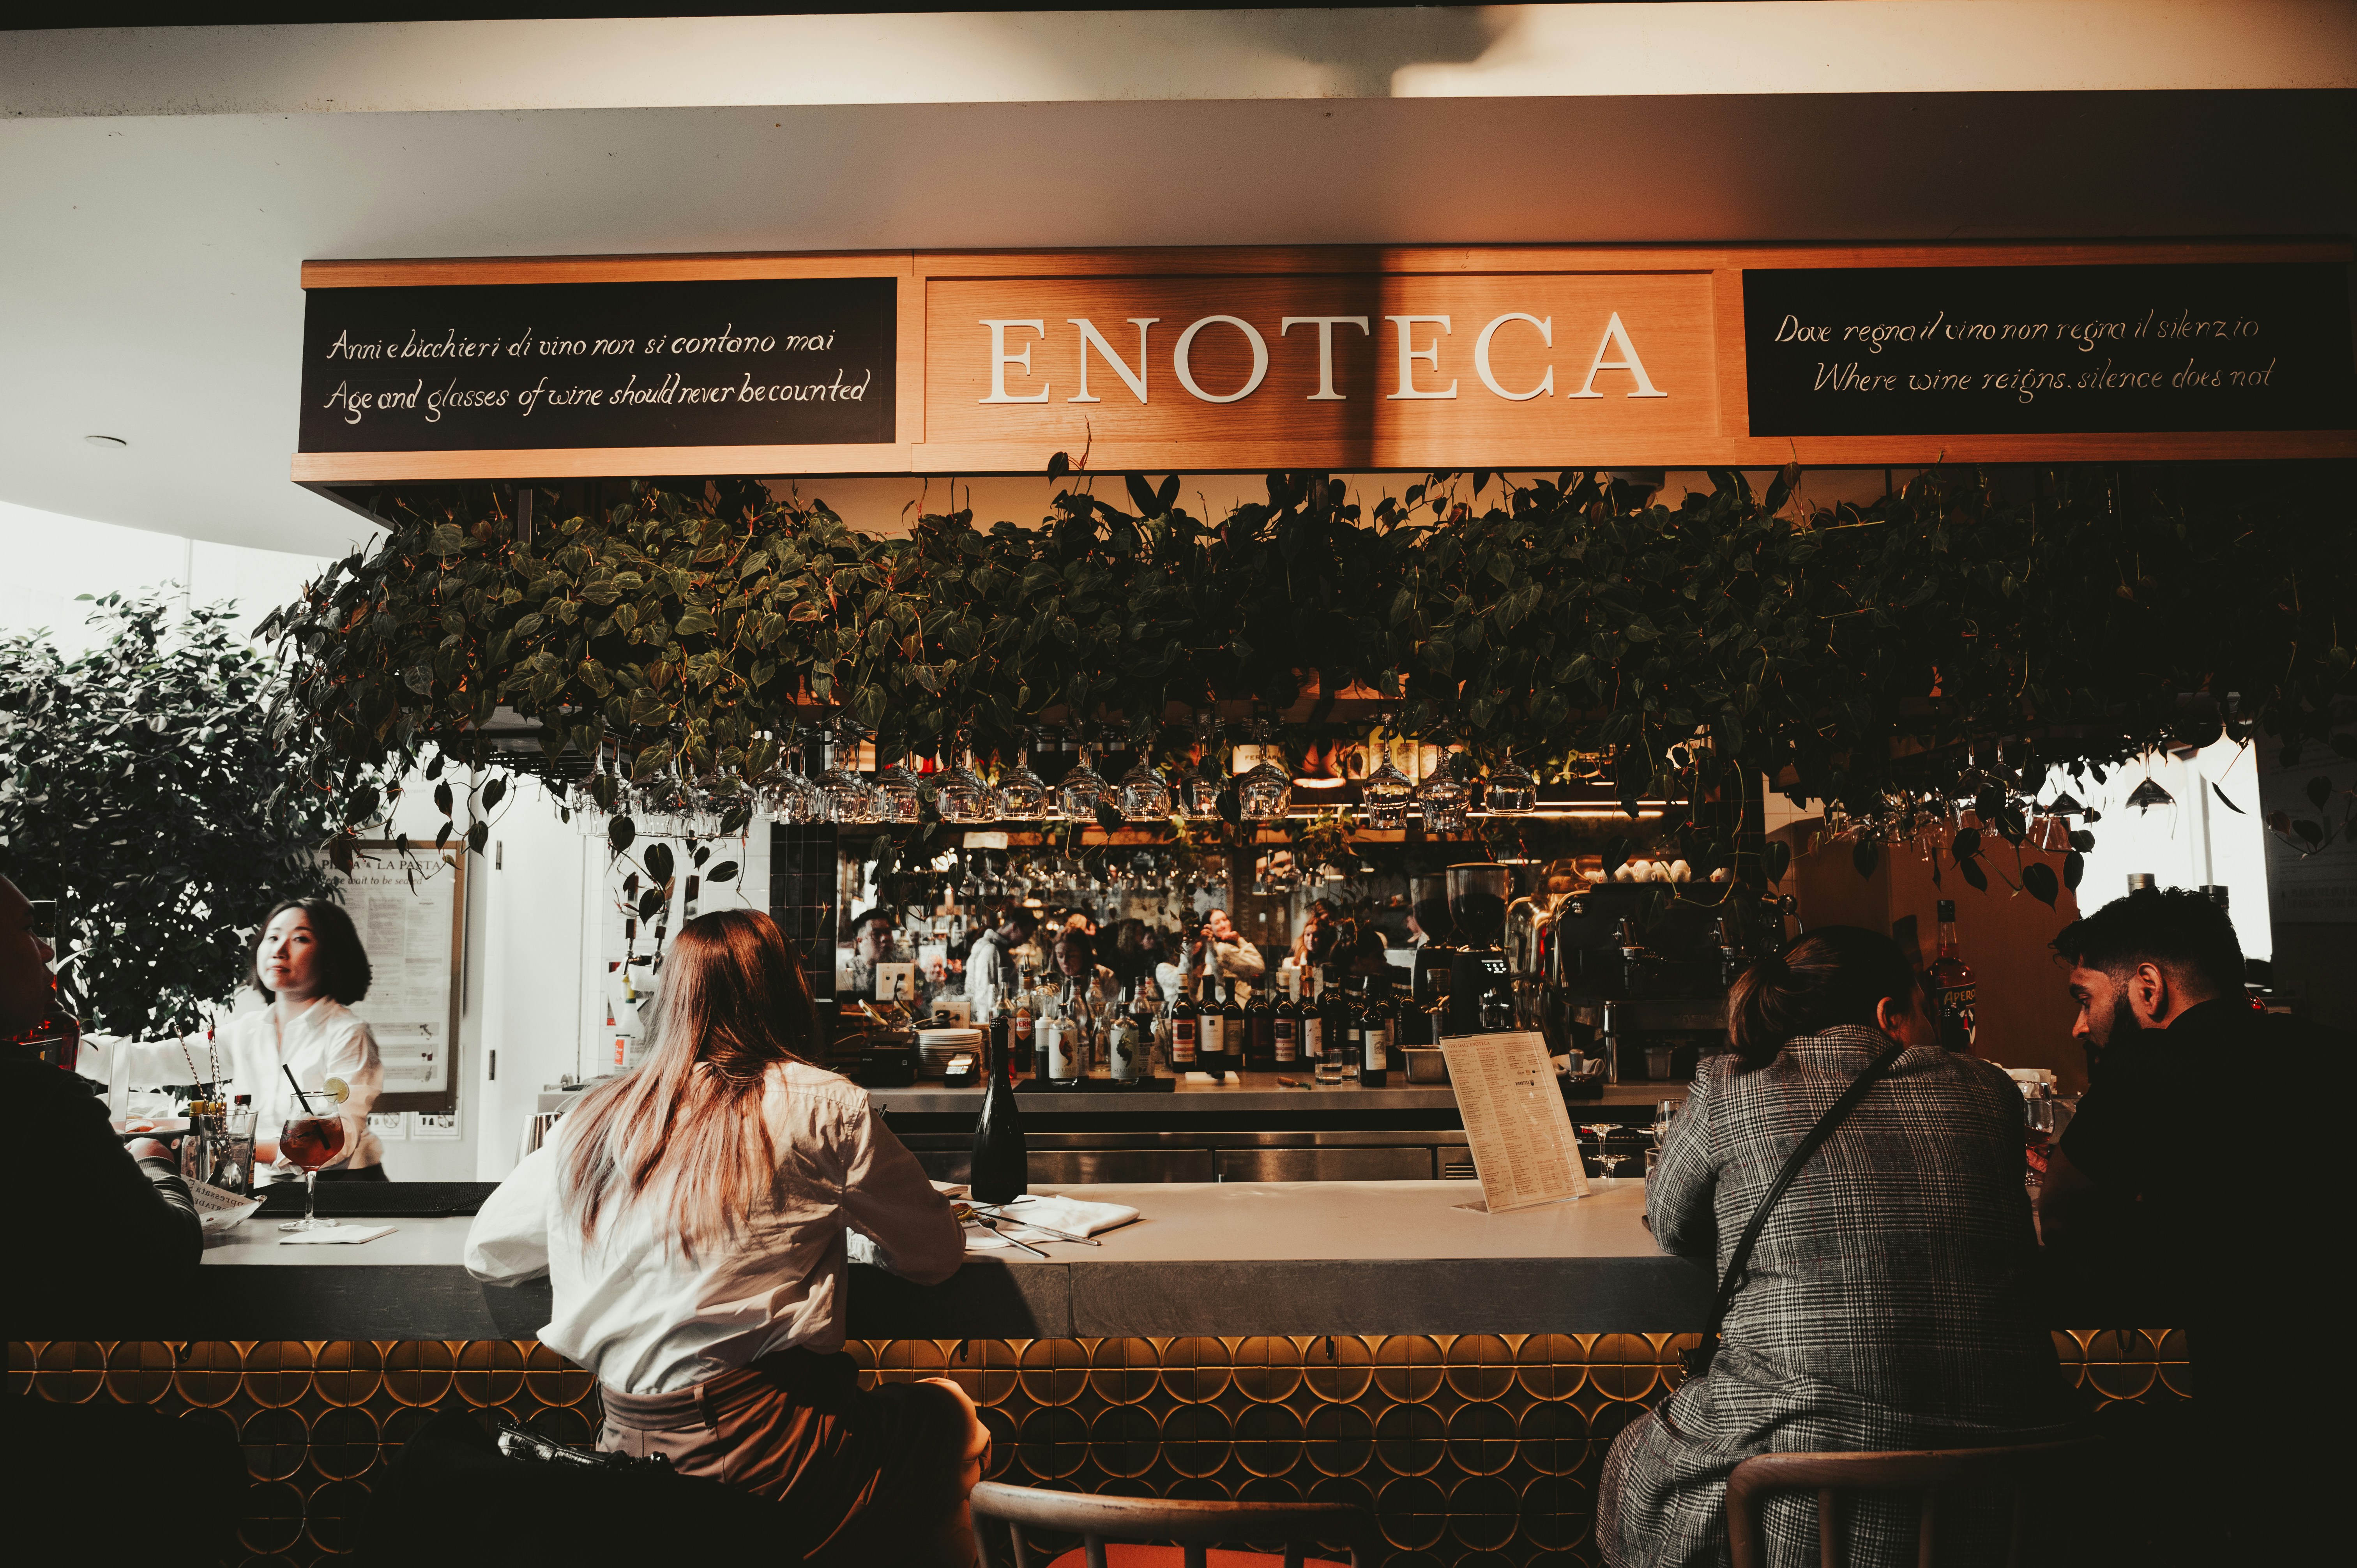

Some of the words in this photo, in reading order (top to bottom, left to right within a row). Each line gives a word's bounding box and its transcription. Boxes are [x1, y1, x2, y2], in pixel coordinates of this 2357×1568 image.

[327, 329, 381, 359] Anni
[387, 344, 398, 358] e
[401, 329, 500, 358] bicchieri
[506, 327, 531, 357] di
[539, 339, 586, 356] vino
[591, 339, 634, 355] non
[645, 337, 666, 354] si
[671, 323, 775, 354] contano
[784, 330, 835, 351] mai
[1774, 315, 1831, 342] Dove
[1843, 324, 1915, 353] regna
[1920, 311, 1944, 340] il
[1946, 322, 1995, 340] vino
[2000, 323, 2048, 341] non
[2056, 323, 2125, 352] regna
[2135, 309, 2154, 338] il
[2157, 309, 2259, 340] silenzio
[978, 311, 1668, 404] ENOTECA
[1814, 362, 1897, 391] Where
[1909, 368, 1972, 390] wine
[2078, 358, 2163, 389] silence
[2172, 358, 2223, 388] does
[2230, 357, 2276, 387] not
[323, 379, 372, 424] Age
[377, 379, 422, 409] and
[425, 377, 507, 422] glasses
[519, 376, 549, 416] of
[548, 387, 603, 406] wine
[610, 373, 679, 405] should
[678, 387, 736, 404] never
[735, 373, 765, 402] be
[766, 368, 871, 402] counted
[322, 860, 360, 869] PIA
[378, 860, 395, 869] LA
[400, 860, 441, 869] PASTA
[348, 876, 367, 885] wait
[371, 876, 379, 885] to
[382, 876, 392, 885] be
[395, 876, 422, 885] seaed
